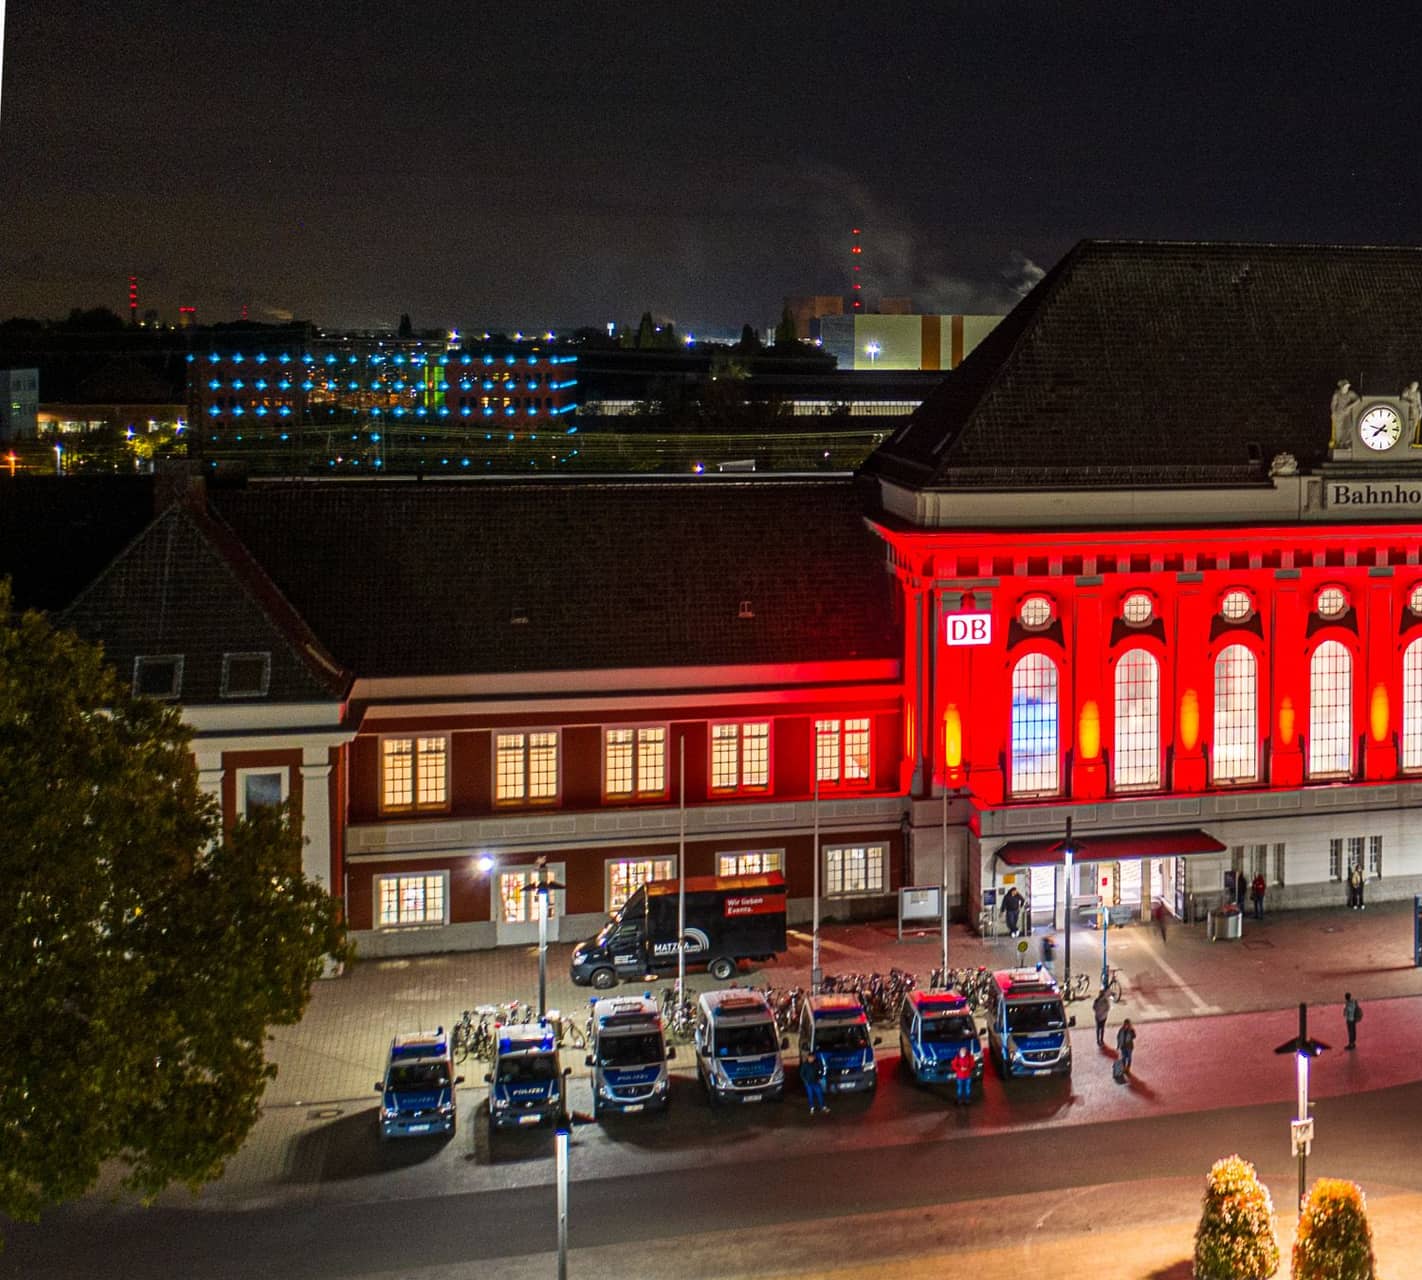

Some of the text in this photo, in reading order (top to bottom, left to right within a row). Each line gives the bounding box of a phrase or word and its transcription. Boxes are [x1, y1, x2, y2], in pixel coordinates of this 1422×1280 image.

[952, 619, 986, 640] DB
[616, 1074, 649, 1082] POLIZEI
[512, 1087, 544, 1096] POLIZEI
